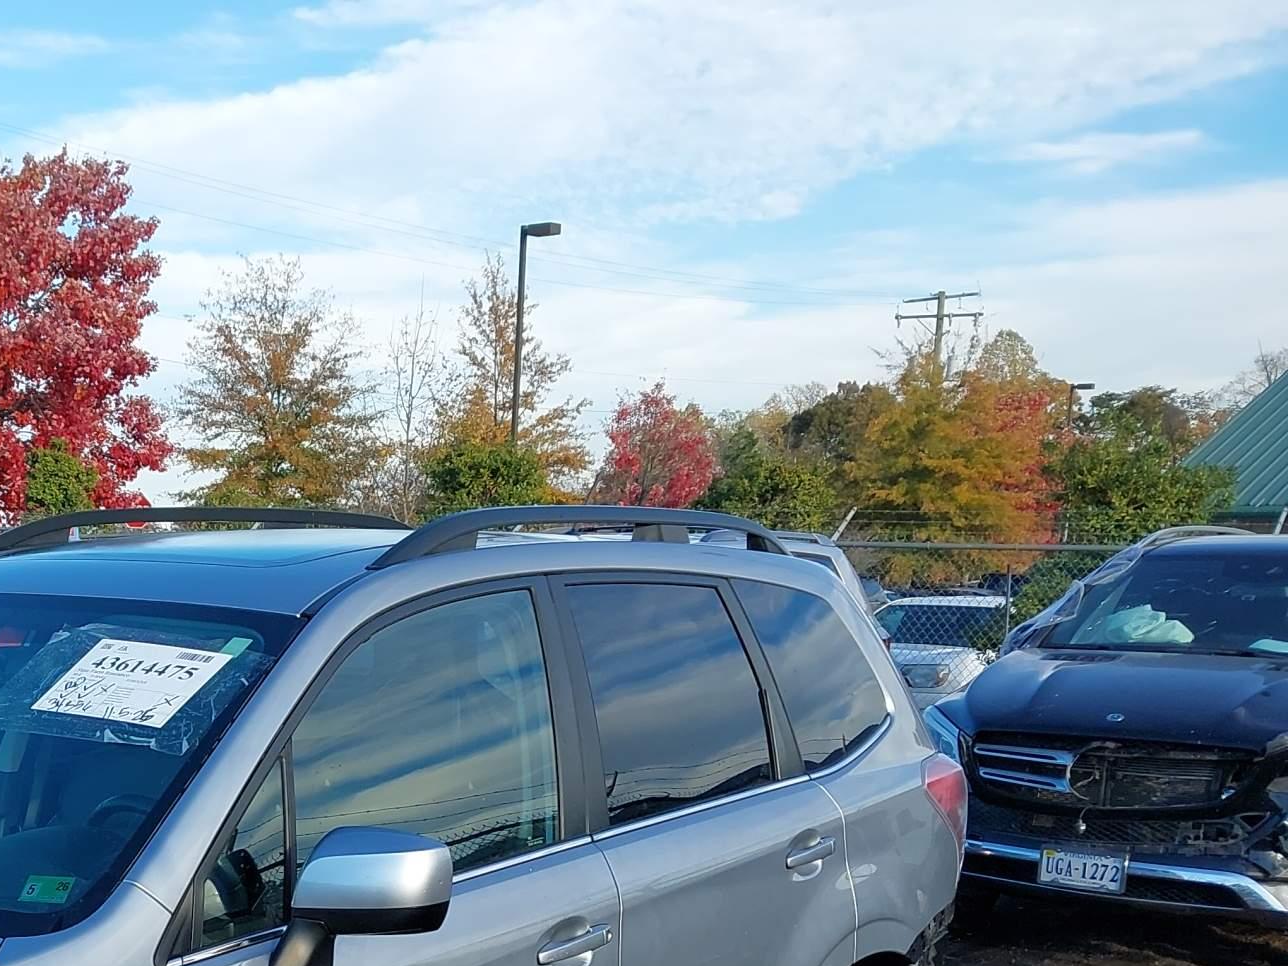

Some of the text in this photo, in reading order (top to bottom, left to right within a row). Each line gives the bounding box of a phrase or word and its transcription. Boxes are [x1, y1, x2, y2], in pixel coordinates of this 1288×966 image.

[91, 655, 200, 681] 43614475
[1045, 855, 1120, 883] UGA-1272
[26, 881, 71, 896] 5 26
